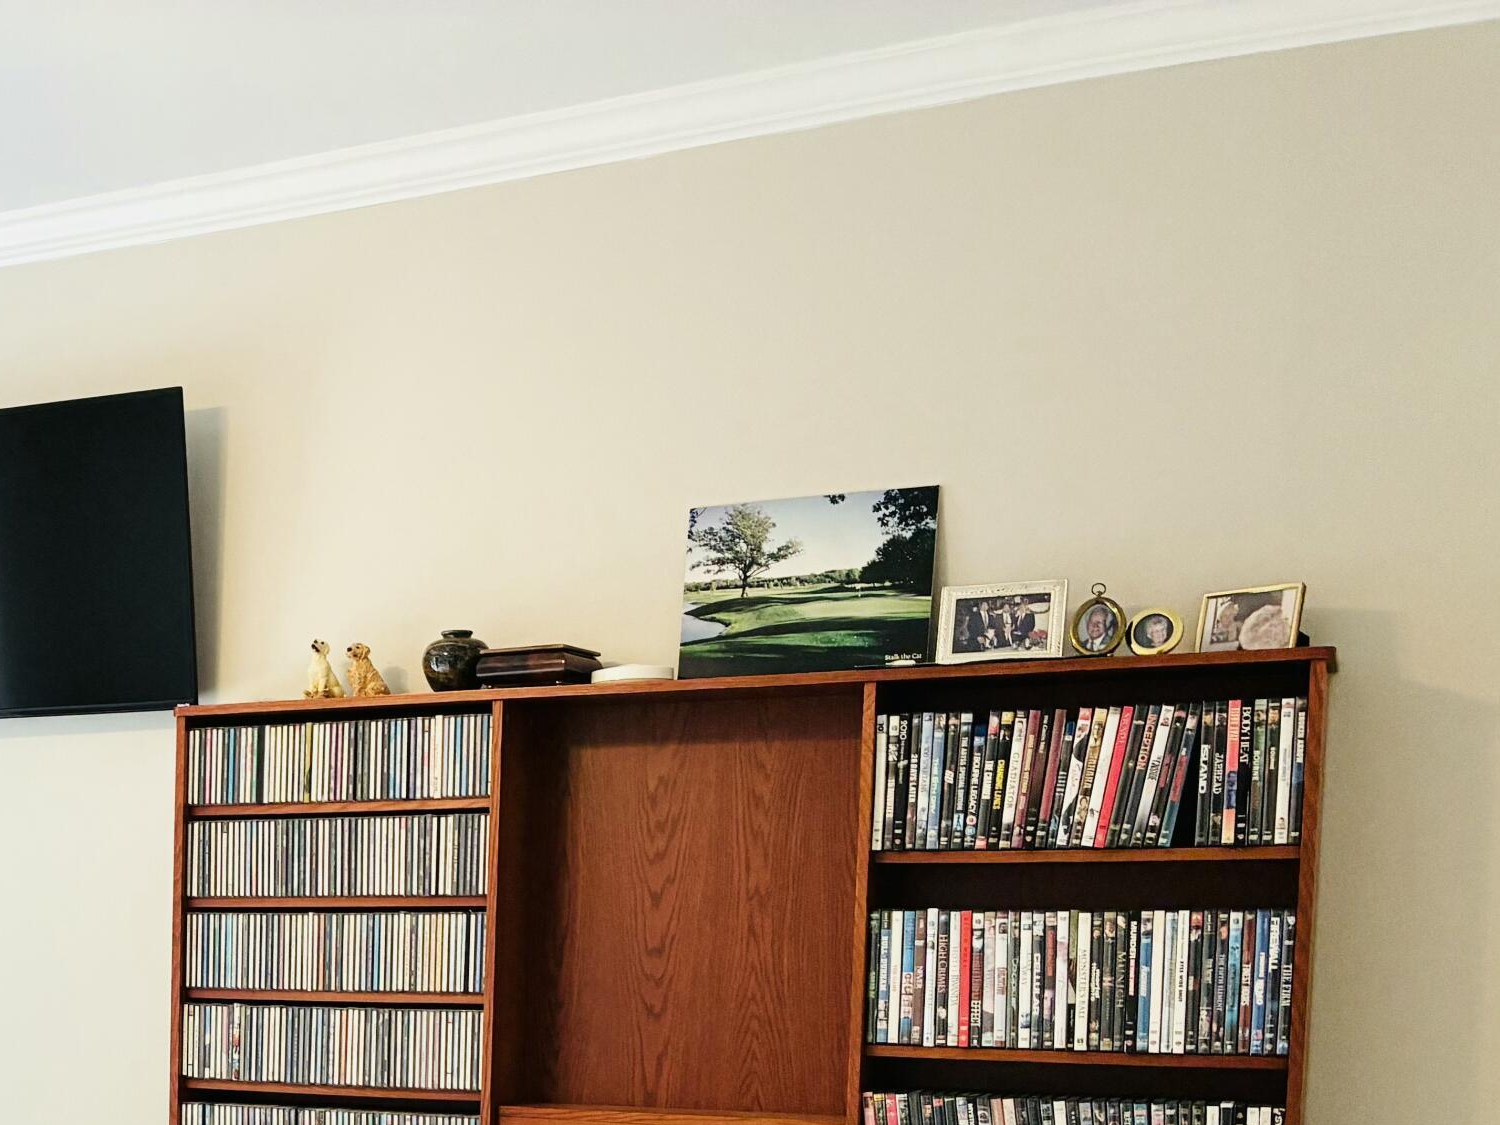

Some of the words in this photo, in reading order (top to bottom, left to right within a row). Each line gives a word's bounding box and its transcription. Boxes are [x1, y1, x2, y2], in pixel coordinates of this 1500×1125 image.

[1241, 706, 1251, 734] BODY
[1137, 714, 1156, 770] INCEPTION
[1006, 752, 1020, 809] GLADIATOR
[1212, 752, 1224, 794] JARHEAD
[969, 786, 979, 814] LEGACY
[939, 934, 948, 959] HIGH
[1130, 921, 1138, 959] MURDER
[1268, 917, 1280, 973] FIREWALL
[938, 961, 948, 993] CRIMES
[1116, 951, 1126, 1008] MUNICH
